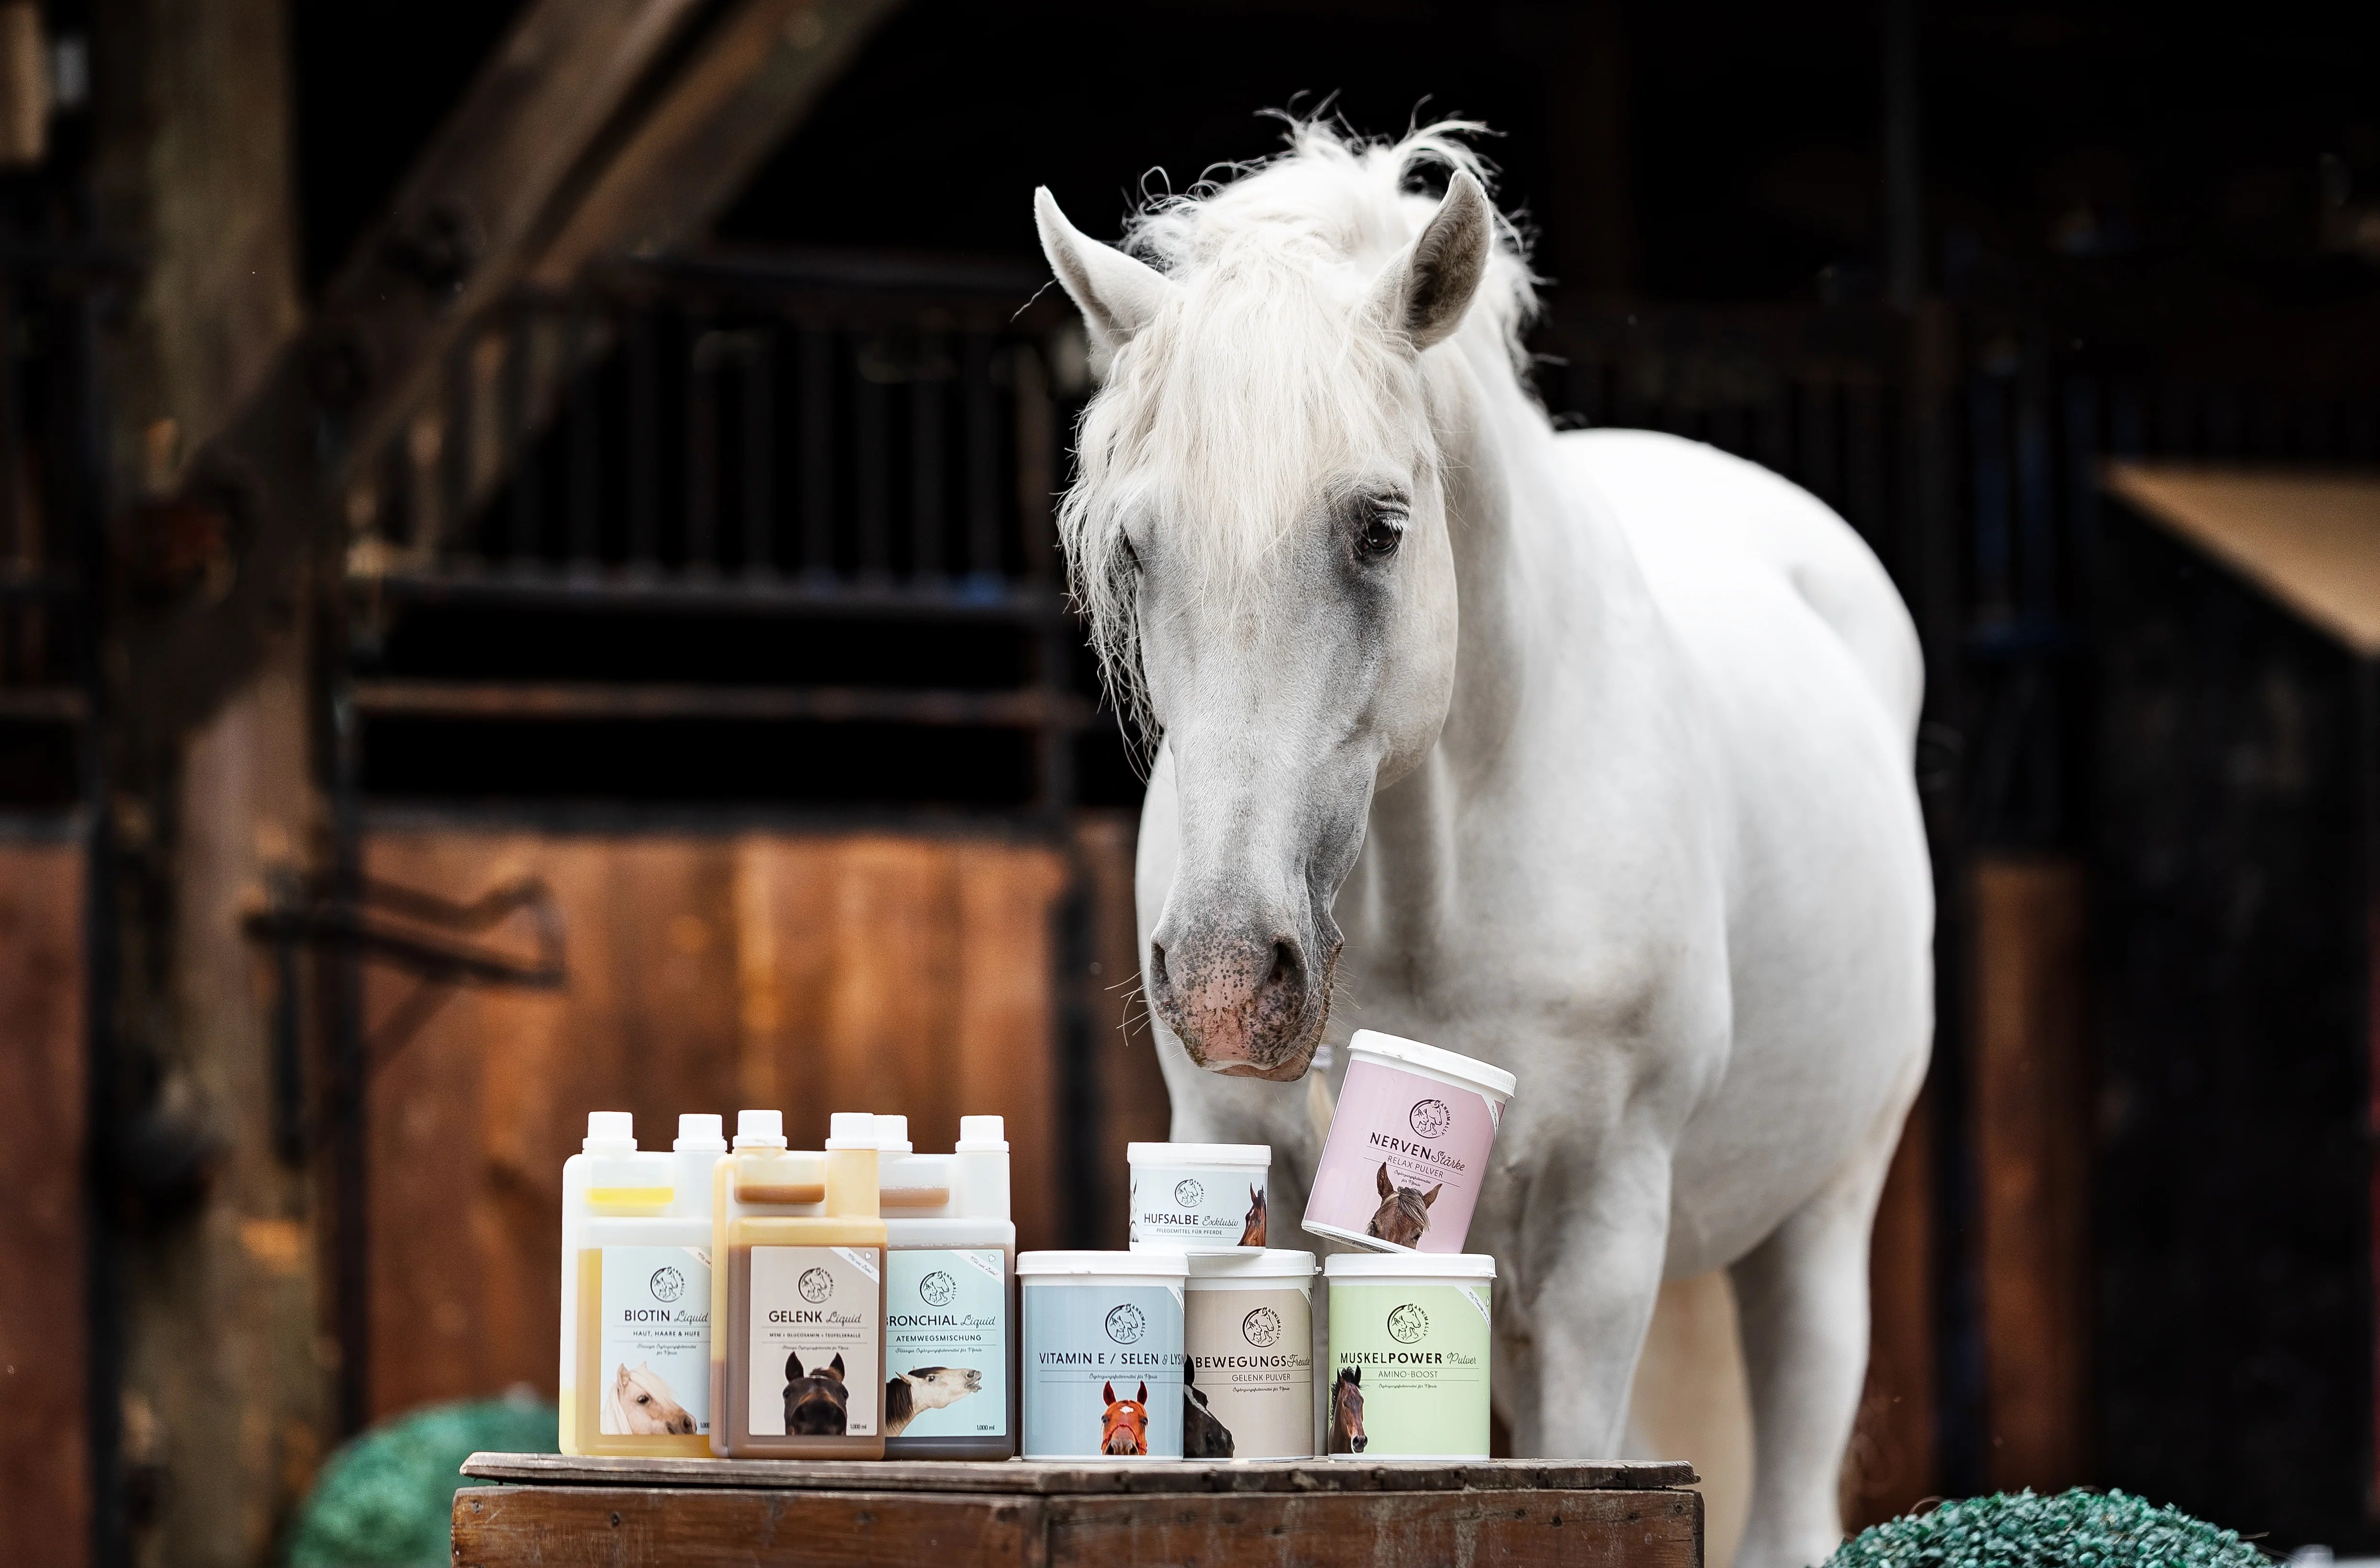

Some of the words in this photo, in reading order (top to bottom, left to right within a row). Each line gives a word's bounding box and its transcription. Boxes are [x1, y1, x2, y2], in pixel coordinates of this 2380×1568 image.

[1387, 1155, 1413, 1169] RELAX
[1414, 1163, 1443, 1179] PULVER
[1144, 1213, 1199, 1225] HUFSALBE
[1202, 1215, 1239, 1227] Exklusiv
[625, 1310, 670, 1321] BIOTIN
[673, 1309, 708, 1326] Liquid
[769, 1310, 822, 1323] GELENK
[826, 1310, 862, 1327] Liquid
[886, 1315, 958, 1326] RONCHIAL
[960, 1313, 996, 1328] Liquid
[1039, 1352, 1092, 1364] VITAMIN
[1098, 1353, 1105, 1364] E
[1110, 1353, 1116, 1364] /
[1121, 1353, 1158, 1364] SELEN
[1340, 1352, 1443, 1364] MUSKELPOWER
[1447, 1351, 1476, 1365] Pulver
[1266, 1373, 1290, 1381] PULVER
